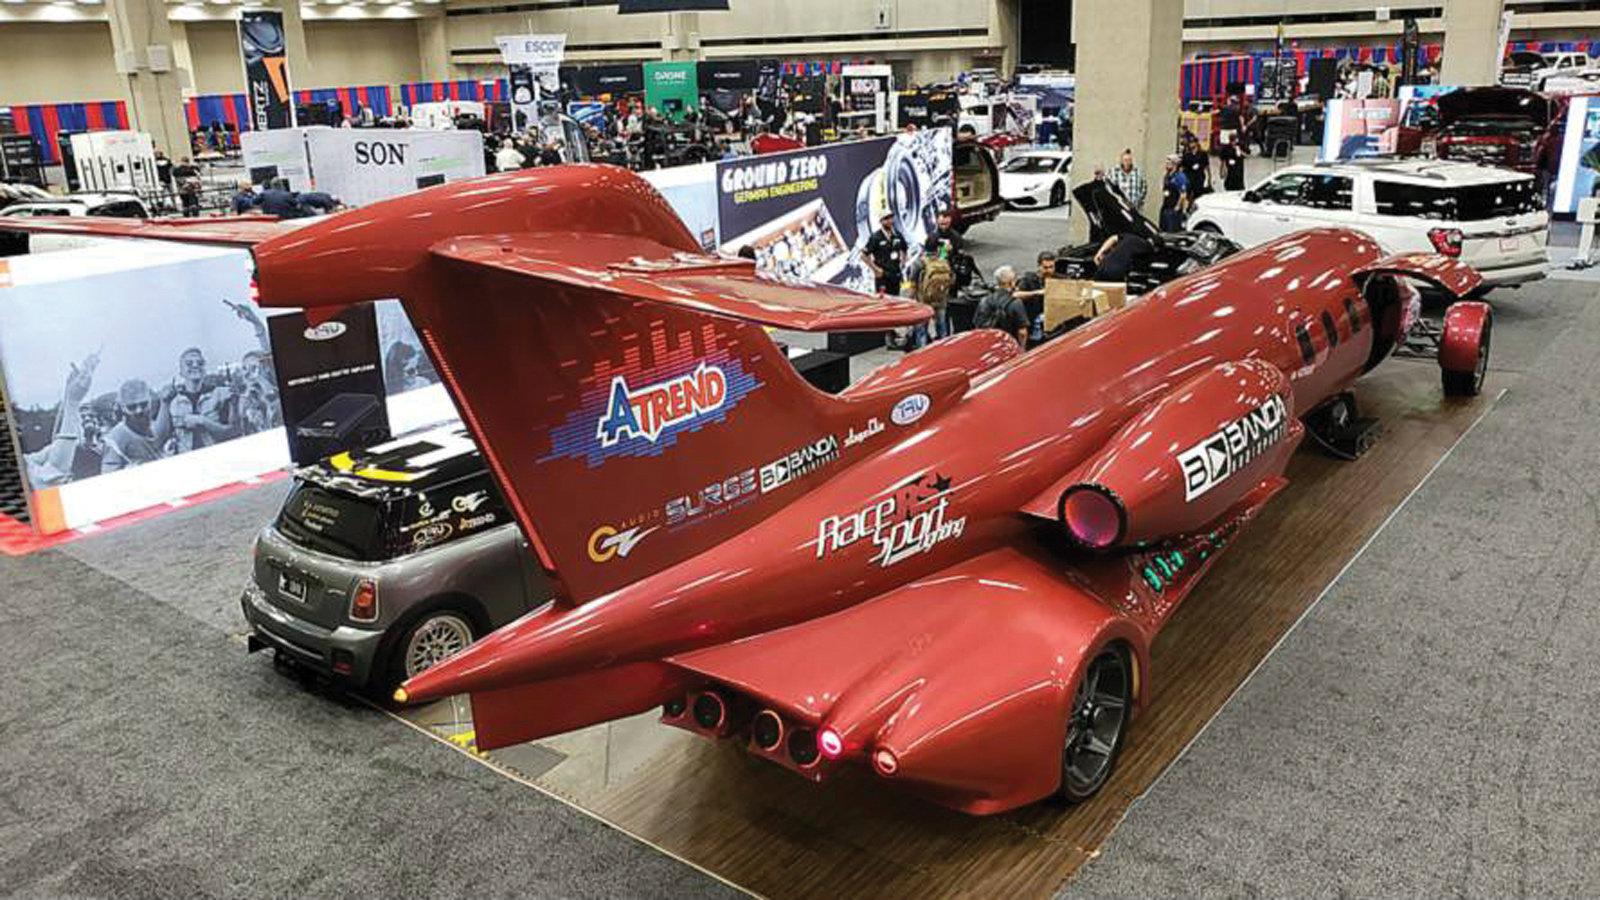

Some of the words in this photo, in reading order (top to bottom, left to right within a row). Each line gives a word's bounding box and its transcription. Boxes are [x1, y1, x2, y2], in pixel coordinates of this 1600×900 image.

[721, 161, 787, 193] GROUND
[789, 154, 828, 180] ZERO
[734, 188, 769, 204] GERMAN
[596, 361, 728, 448] ATREND
[1225, 393, 1287, 455] BANDA
[789, 434, 839, 469] BANDA
[665, 467, 758, 525] SURGE
[816, 497, 896, 559] Race
[868, 496, 949, 568] Sport
